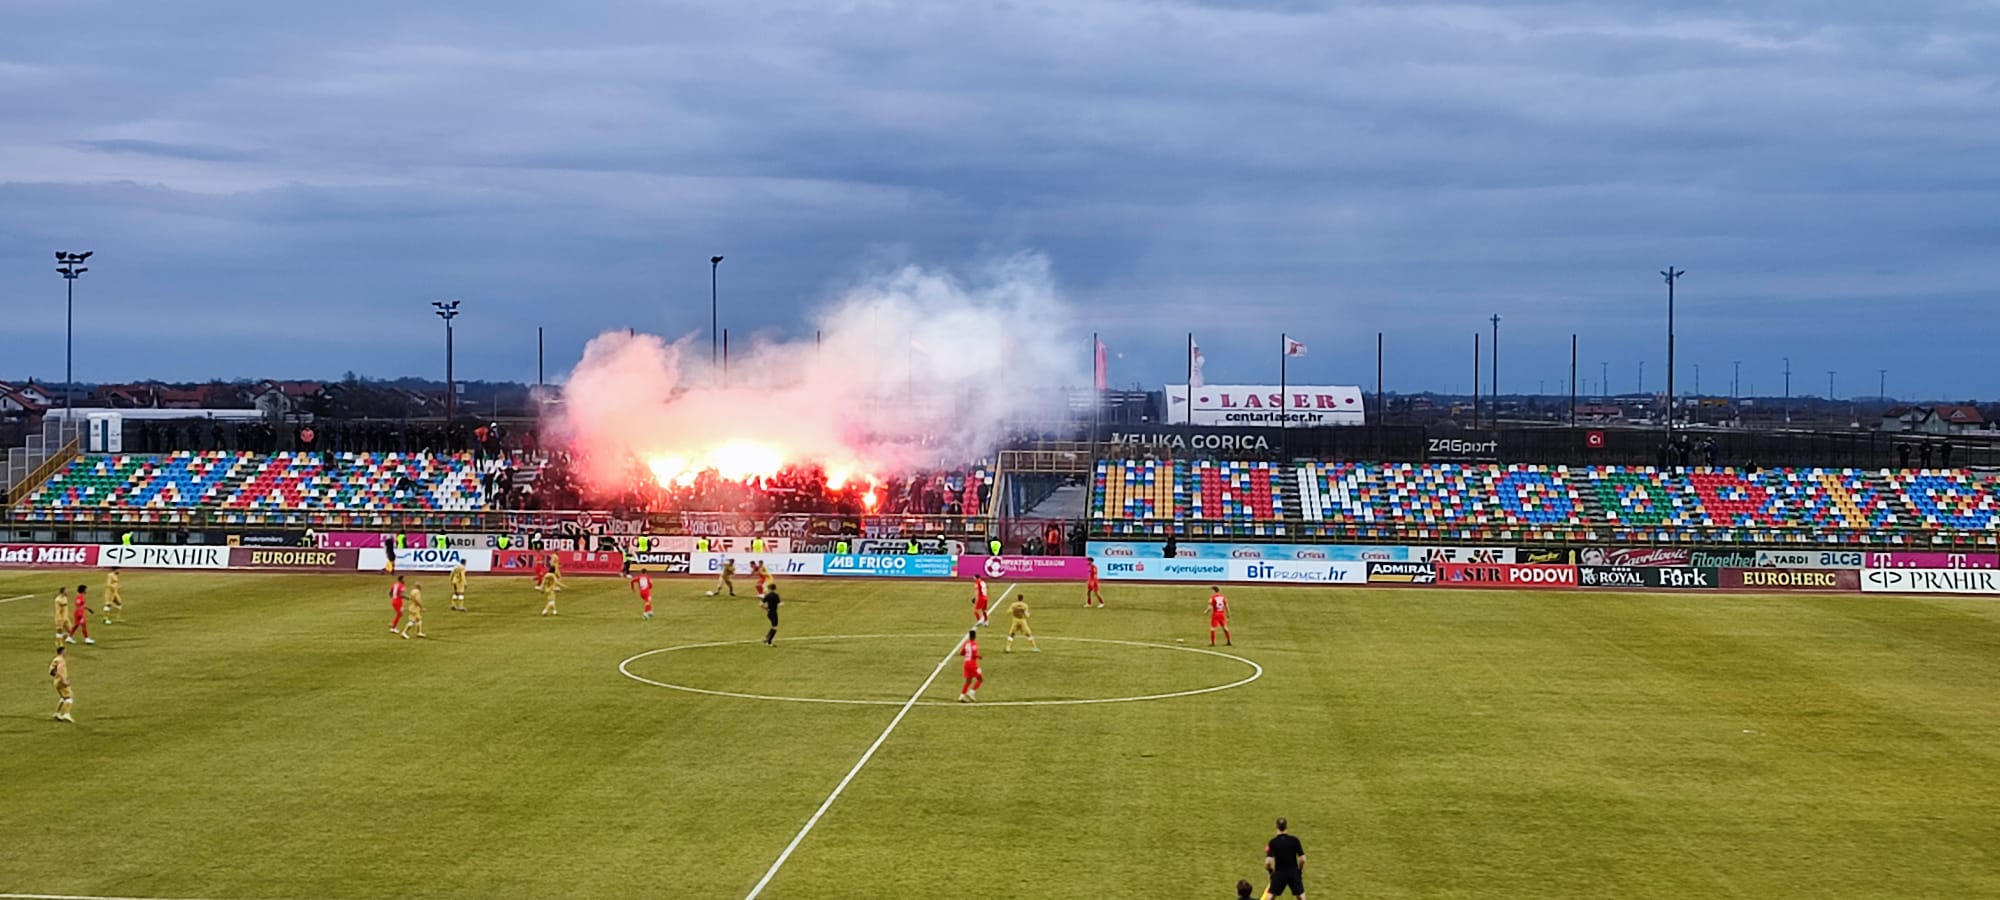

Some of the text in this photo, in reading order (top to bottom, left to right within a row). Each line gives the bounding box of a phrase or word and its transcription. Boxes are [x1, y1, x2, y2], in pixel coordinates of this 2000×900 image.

[1219, 393, 1338, 409] LASER
[1225, 411, 1324, 423] centarlaser.hr
[1112, 433, 1269, 450] VELIKA GORICA
[36, 546, 87, 563] Milić
[143, 548, 219, 566] PRAHIR
[413, 550, 461, 562] KOVA
[1105, 546, 1133, 557] Cetina
[1176, 548, 1197, 558] etina
[1232, 549, 1261, 559] Cetina
[1296, 550, 1326, 560] Cetina
[1361, 551, 1391, 561] Cetina
[1420, 547, 1457, 563] JAF
[251, 551, 337, 565] EUROHERC
[829, 556, 854, 568] MB
[859, 556, 906, 569] FRIGO
[1774, 555, 1809, 564] TARDI
[1107, 563, 1134, 571] ERSTE
[1164, 564, 1224, 574] #vjerujusebe
[1371, 564, 1436, 574] ADMIRAL
[1509, 568, 1574, 583] PODOVI
[1743, 572, 1837, 586] EUROHERC
[1910, 571, 1997, 590] PRAHIR
